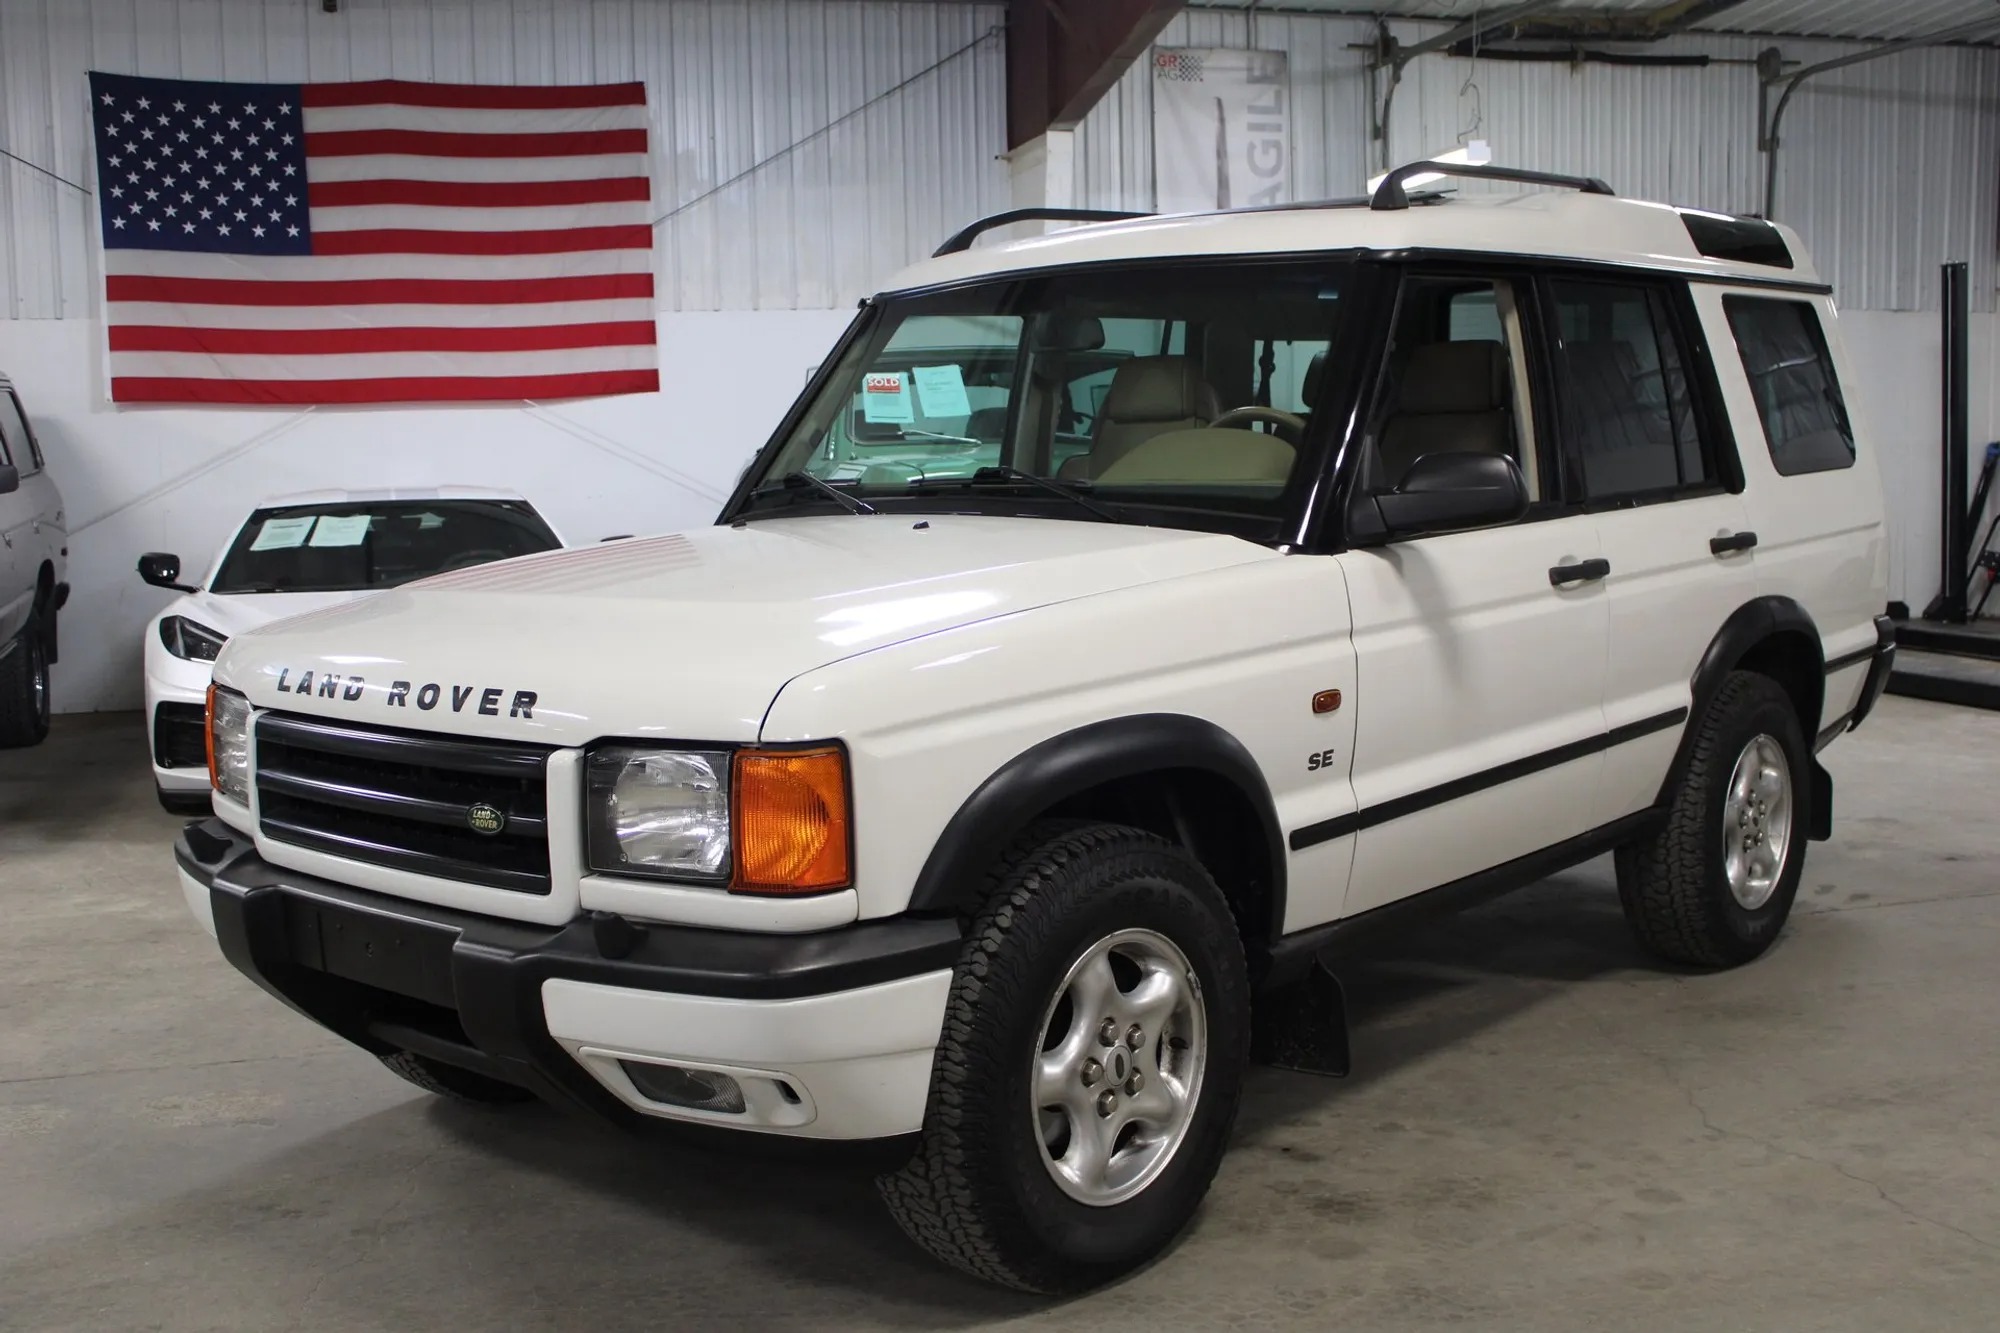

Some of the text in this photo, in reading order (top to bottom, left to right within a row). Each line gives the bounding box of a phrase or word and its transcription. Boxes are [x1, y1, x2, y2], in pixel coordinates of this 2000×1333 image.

[1157, 54, 1178, 68] GR
[1157, 68, 1179, 81] AG
[867, 378, 900, 387] SOLD
[277, 667, 538, 719] LAND ROVER
[1307, 748, 1335, 771] SE
